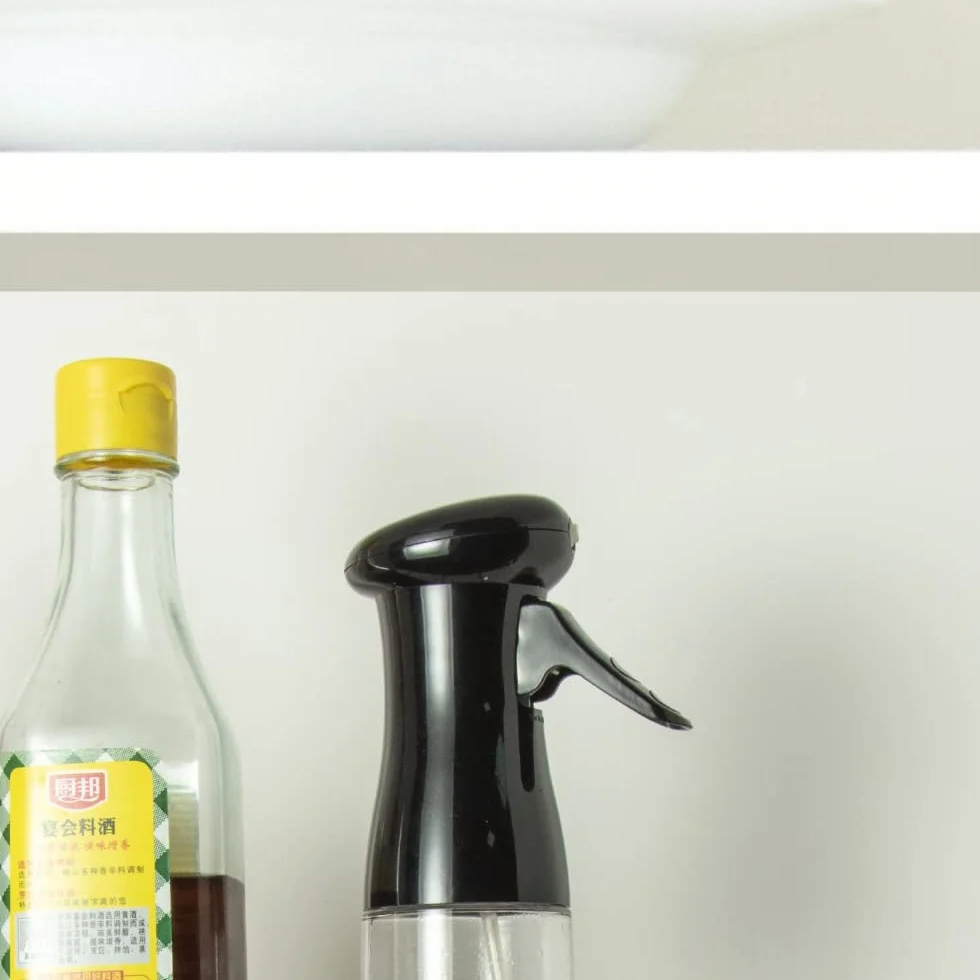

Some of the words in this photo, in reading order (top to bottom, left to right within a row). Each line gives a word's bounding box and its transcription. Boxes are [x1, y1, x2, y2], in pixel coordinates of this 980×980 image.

[55, 777, 100, 799] 厨邦
[42, 817, 116, 837] 宴会料酒
